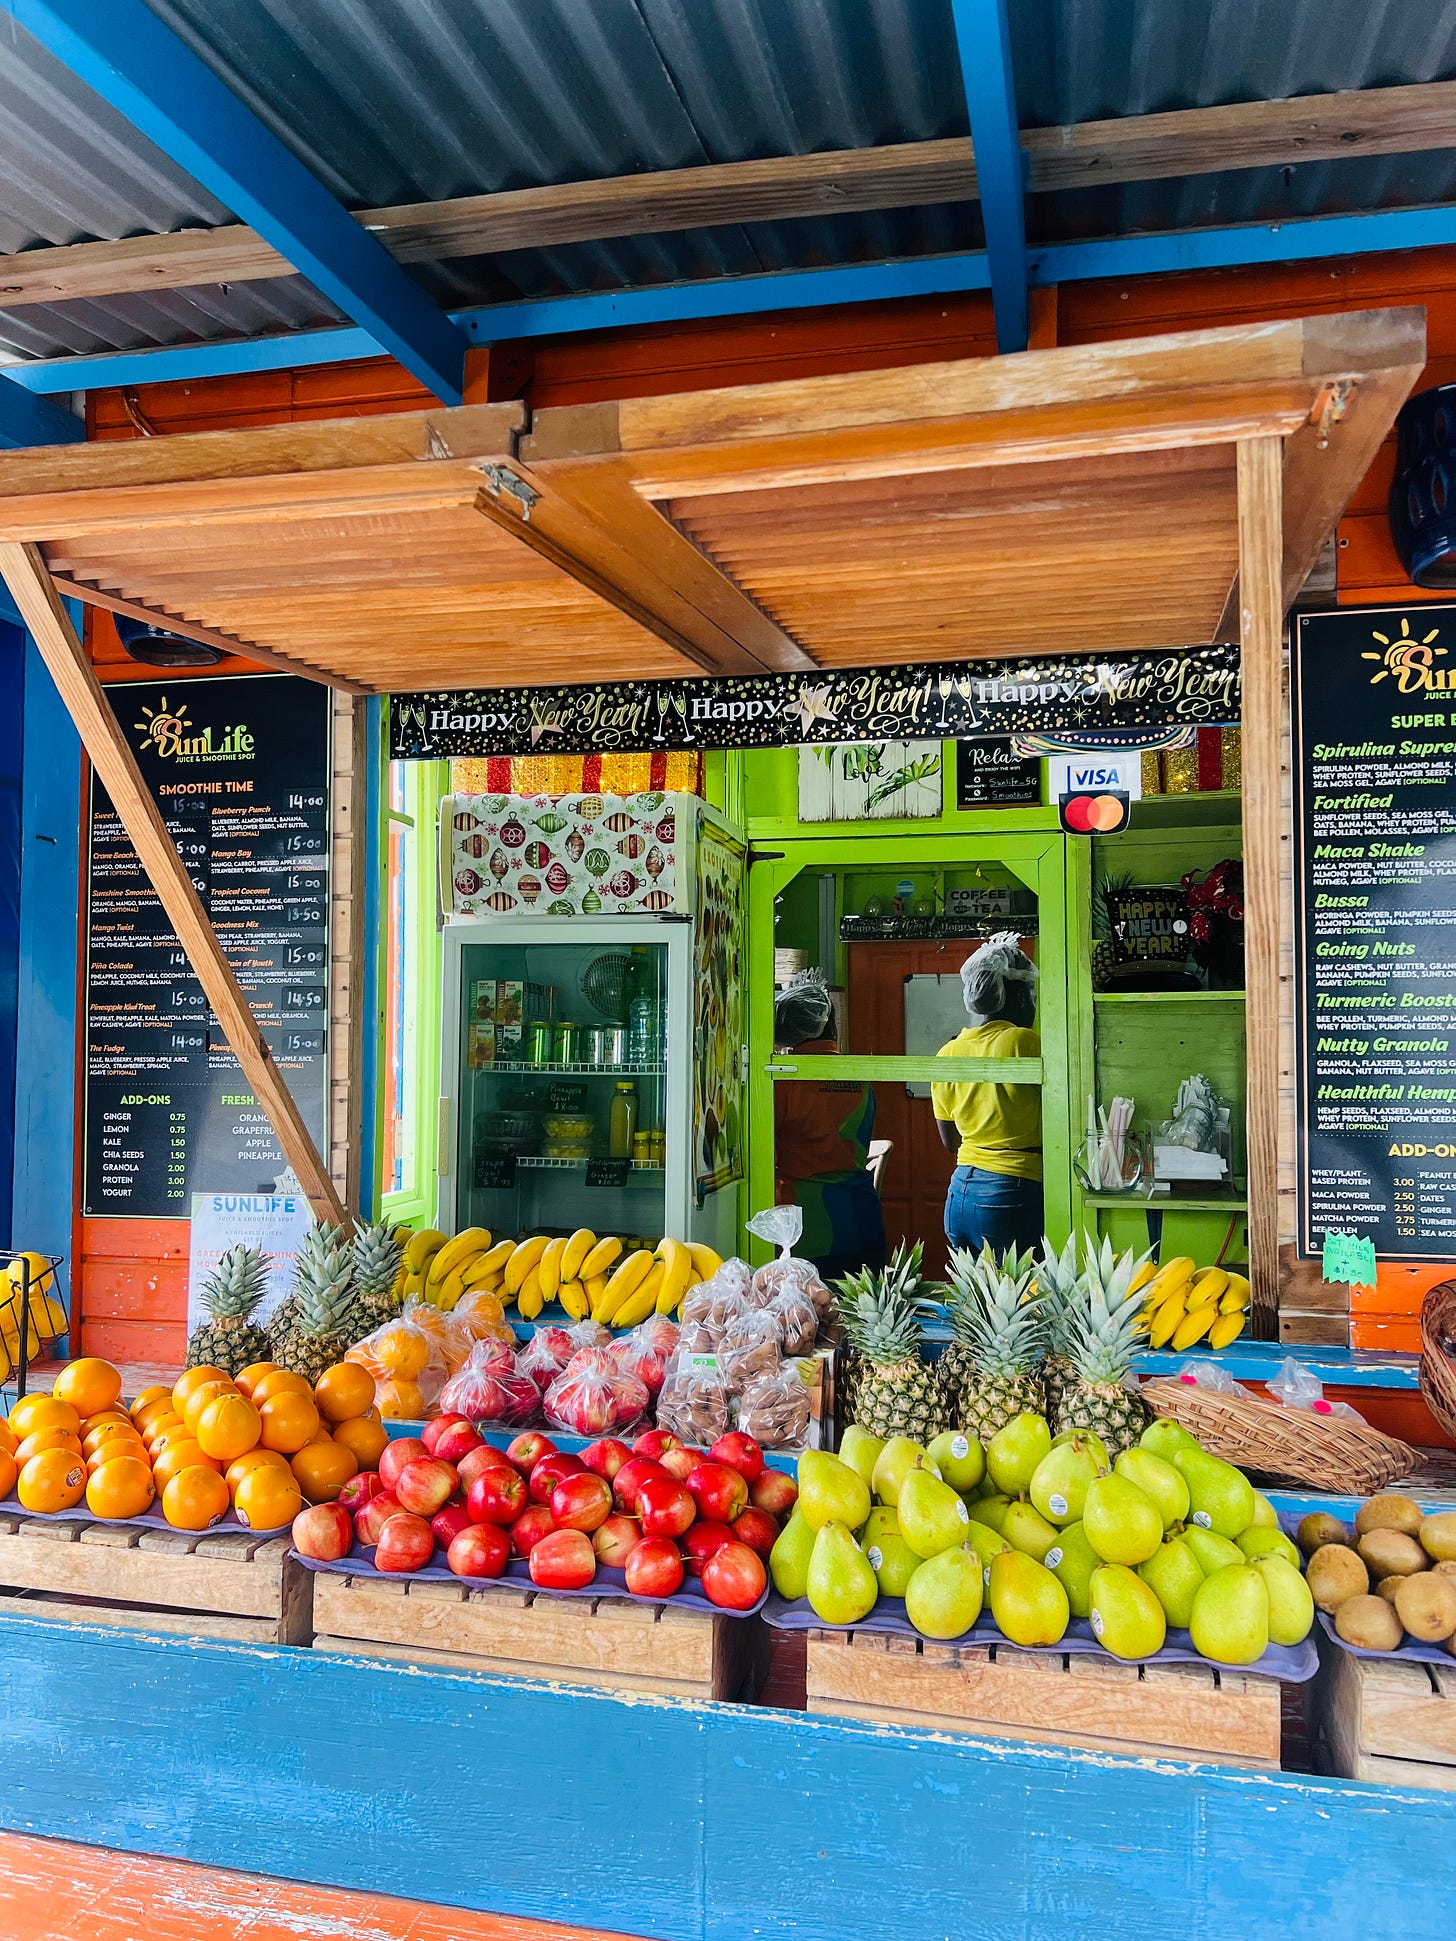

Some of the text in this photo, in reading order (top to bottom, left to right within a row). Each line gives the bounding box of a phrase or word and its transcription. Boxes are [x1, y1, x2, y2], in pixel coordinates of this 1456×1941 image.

[976, 680, 1085, 705] Happy
[1082, 662, 1156, 706] New
[1424, 691, 1451, 700] JUICE
[691, 698, 785, 722] Happy
[850, 676, 932, 734] Year!
[429, 693, 652, 746] Happy New Year!
[1391, 713, 1446, 729] SUPER
[154, 719, 255, 757] SunLife
[1312, 741, 1456, 761] Spirulina Supre
[844, 753, 890, 783] Love
[1312, 765, 1353, 773] SPIRULINA
[1355, 764, 1392, 772] POWDER,
[1393, 762, 1429, 770] ALMOND
[1074, 768, 1120, 785] VISA
[159, 781, 254, 795] SMOOTHIE TIME
[1314, 793, 1394, 809] Fortified
[211, 806, 271, 816] Blueberry Punch
[176, 841, 206, 854] 5.00
[1314, 842, 1425, 858] Maca Shake
[211, 850, 252, 859] Mango Bay
[211, 888, 240, 897] Tropical
[951, 889, 1007, 900] COFFEE
[1315, 894, 1369, 908] Bussa
[972, 904, 1002, 913] TEA
[1118, 902, 1178, 919] HAPPY
[1356, 911, 1393, 919] POWDER,
[1394, 910, 1430, 918] PUMPKIN
[91, 925, 115, 933] Mango
[211, 921, 244, 929] Goodness
[1128, 919, 1172, 937] NEW
[1124, 936, 1179, 955] YEAR!
[1316, 942, 1416, 960] Going Nuts
[108, 962, 134, 970] Colada
[248, 1001, 273, 1009] Crunch
[1316, 993, 1397, 1008] Turmeric
[103, 1045, 125, 1054] Fudge
[1316, 1037, 1449, 1056] Nutty Granola
[1318, 1084, 1404, 1099] Healthful
[120, 1095, 171, 1105] ADD-ONS
[221, 1095, 254, 1105] FRESH
[103, 1113, 186, 1121] GINGER 0.75
[239, 1114, 269, 1122] ORAN
[103, 1125, 186, 1134] LEMON 0.75
[232, 1127, 275, 1135] GRAPEFRU
[103, 1138, 186, 1147] KALE 1.50
[245, 1139, 271, 1147] APPLE
[103, 1151, 121, 1159] CHIA
[122, 1151, 145, 1159] SEEDS
[238, 1152, 282, 1160] PINEAPPLE
[103, 1164, 185, 1172] GRANOLA 2.00
[1312, 1169, 1361, 1177] WHEY/PLANT
[102, 1176, 185, 1185] PROTEIN 3.00
[1393, 1179, 1414, 1187] 3.00
[102, 1189, 185, 1198] YOGURT 2.00
[1394, 1193, 1415, 1201] 2.50
[213, 1197, 296, 1213] SUNLIFE
[1353, 1204, 1387, 1212] POWDER
[1394, 1204, 1415, 1212] 2.50
[1346, 1215, 1380, 1223] POWDER
[1395, 1216, 1415, 1224] 2.75
[1397, 1228, 1415, 1236] 1.50
